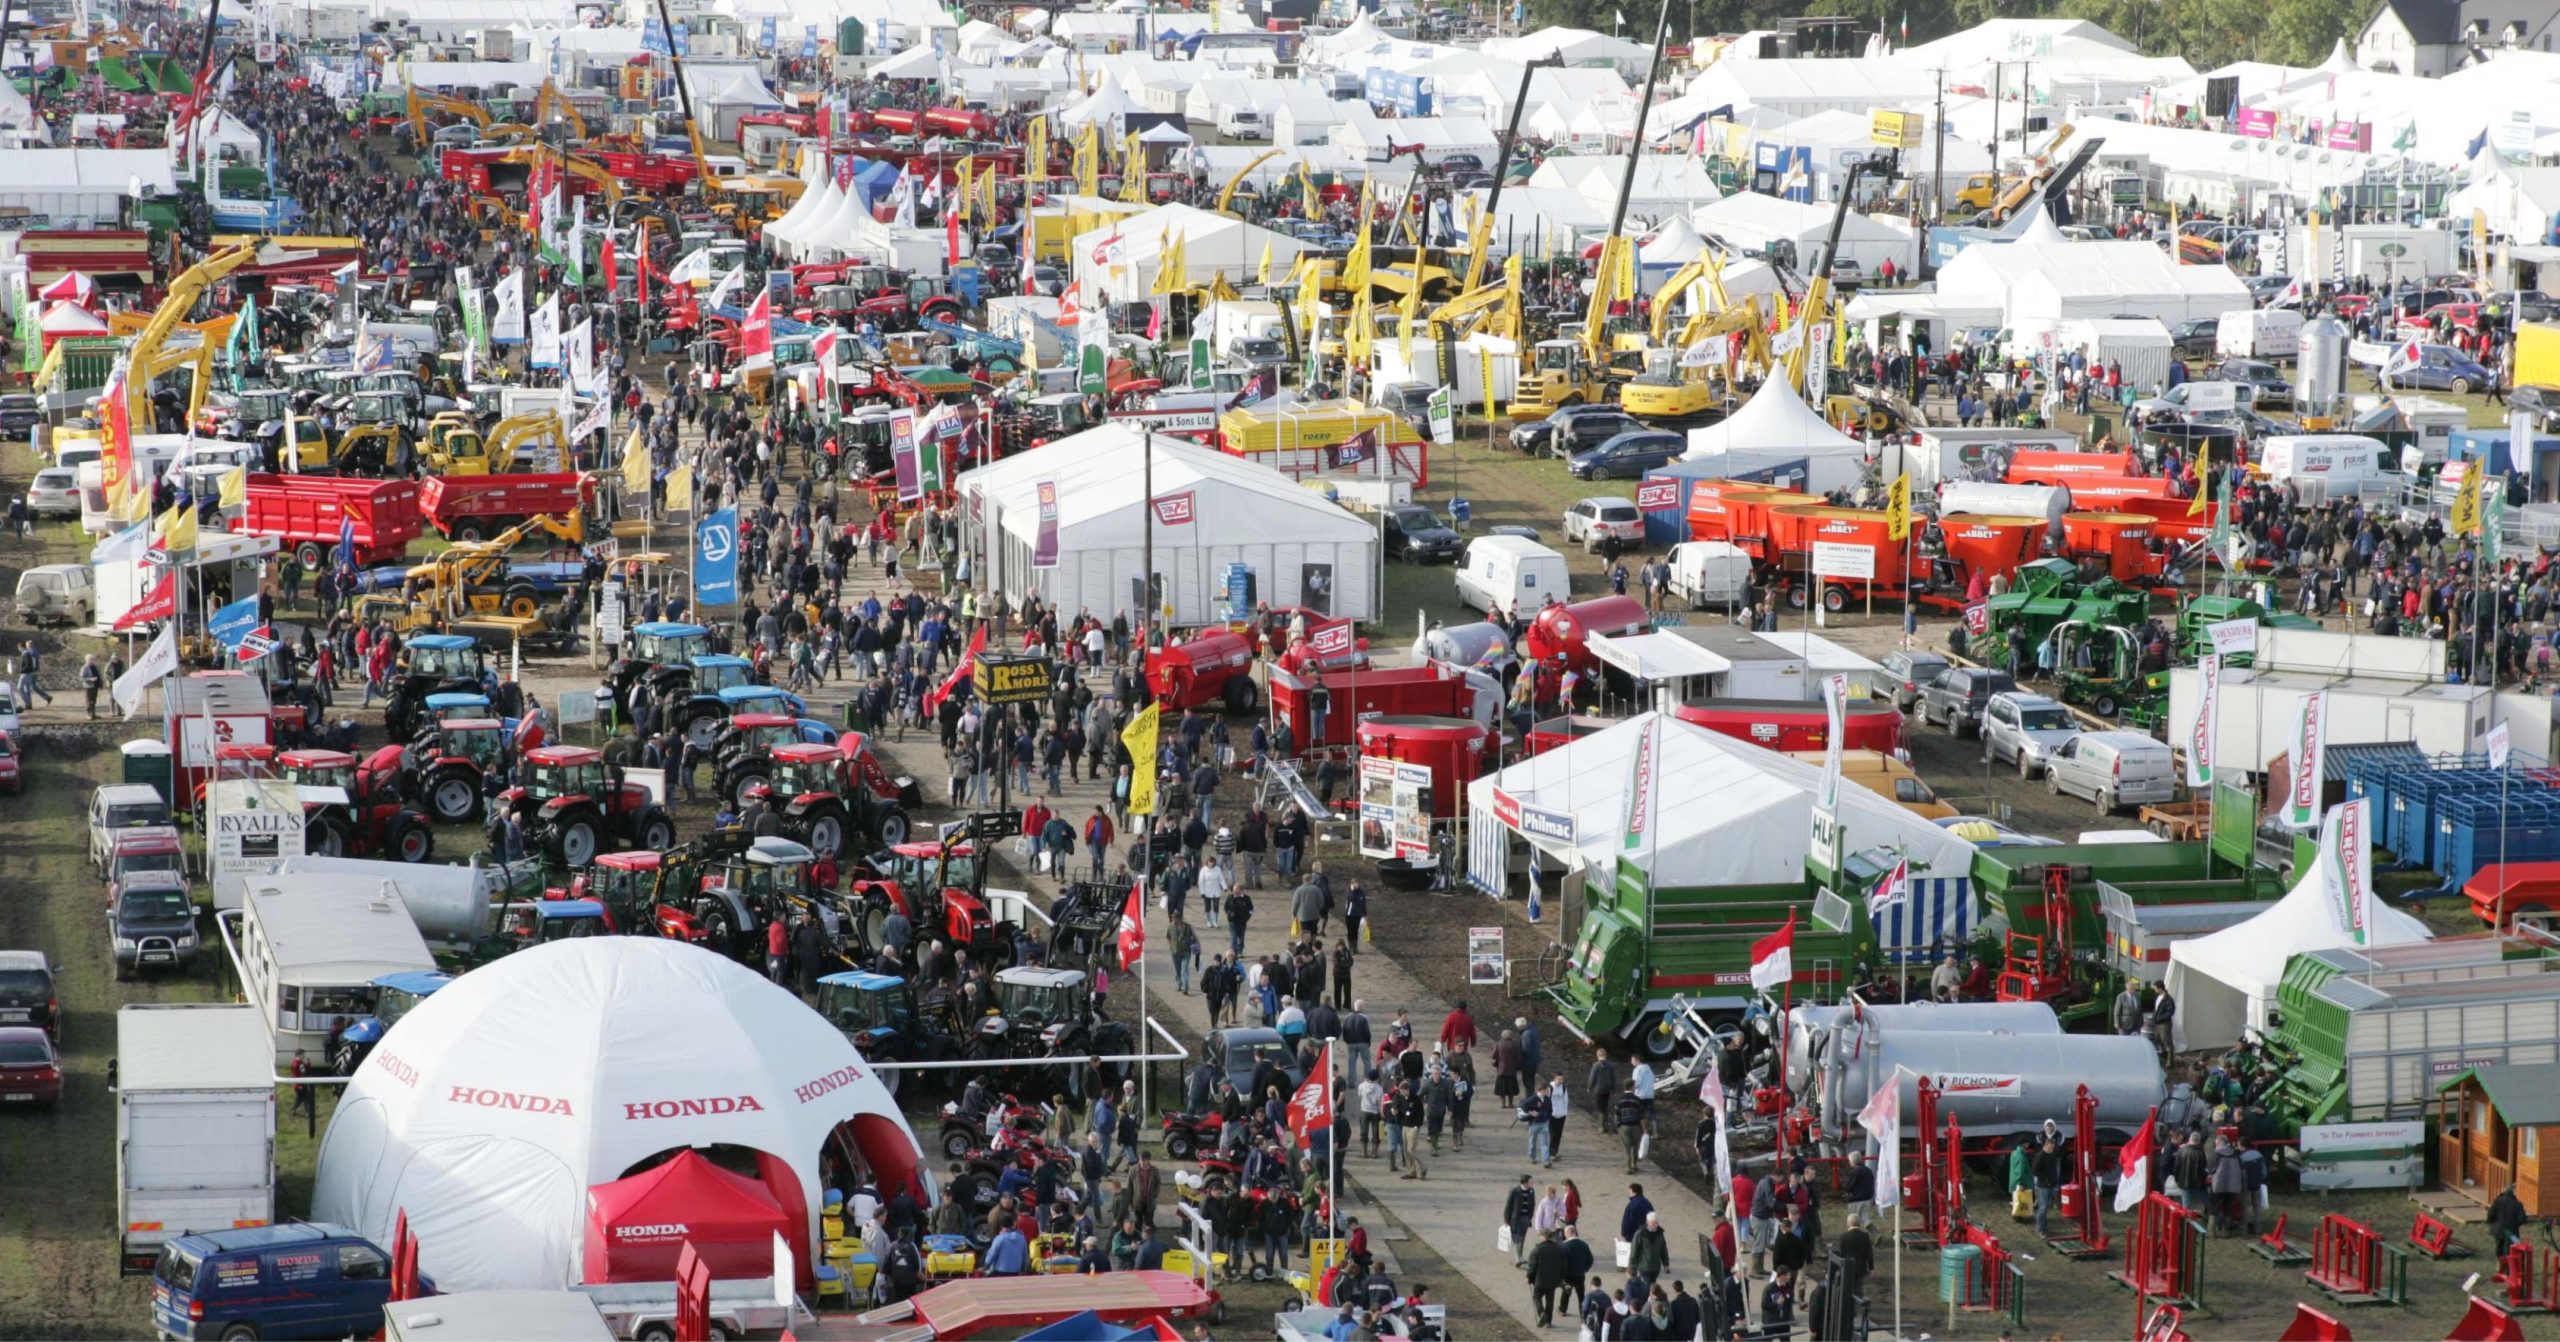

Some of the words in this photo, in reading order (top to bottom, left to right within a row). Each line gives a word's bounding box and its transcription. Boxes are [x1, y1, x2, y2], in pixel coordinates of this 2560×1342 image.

[1176, 416, 1194, 426] Sons
[1197, 414, 1212, 425] Ltd.
[1965, 530, 1993, 538] ABBEY
[2119, 530, 2148, 538] ABBEY
[1011, 675, 1049, 688] MORE
[991, 691, 1048, 702] ENGINEERING
[1400, 770, 1427, 782] Philmac
[220, 813, 301, 832] RYALL'S
[1524, 812, 1570, 838] Philmac
[376, 1048, 420, 1089] HONDA
[794, 1065, 863, 1105] HONDA
[1952, 1076, 1997, 1087] PICHON
[448, 1086, 574, 1116] HONDA
[624, 1095, 764, 1120] HONDA
[616, 1223, 689, 1237] HONDA
[277, 1254, 321, 1266] HONDA
